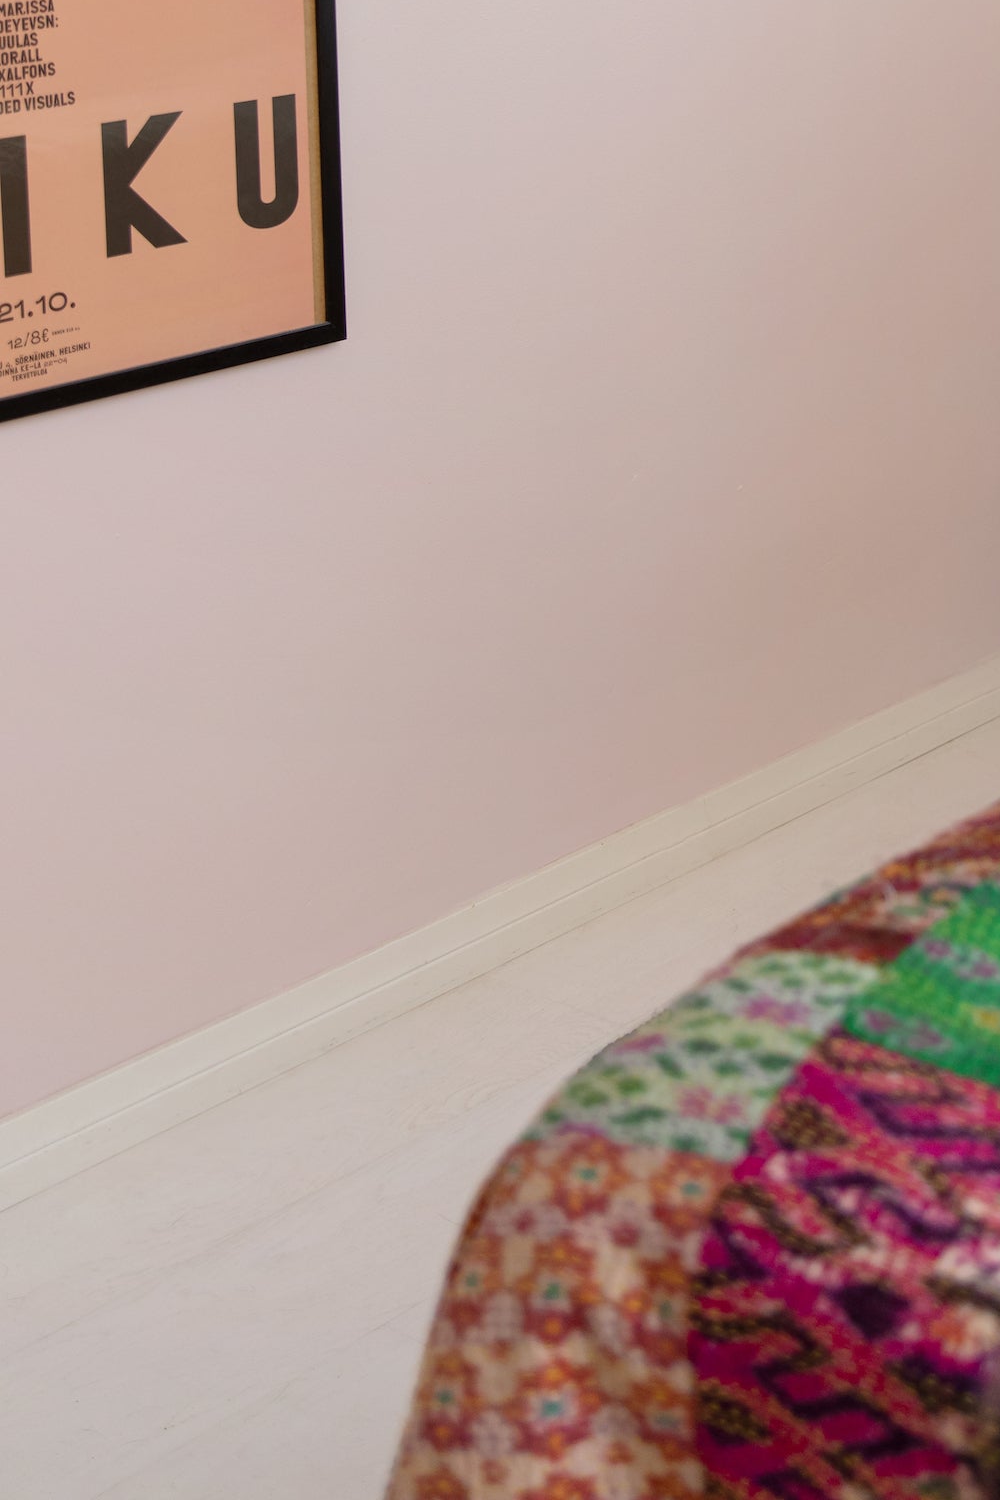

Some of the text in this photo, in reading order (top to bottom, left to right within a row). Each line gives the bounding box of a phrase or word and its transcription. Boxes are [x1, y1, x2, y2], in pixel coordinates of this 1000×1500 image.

[24, 91, 76, 112] VISUALS
[0, 292, 76, 324] 21.10.
[7, 328, 49, 350] 12/8€
[59, 342, 91, 356] HELSINKI
